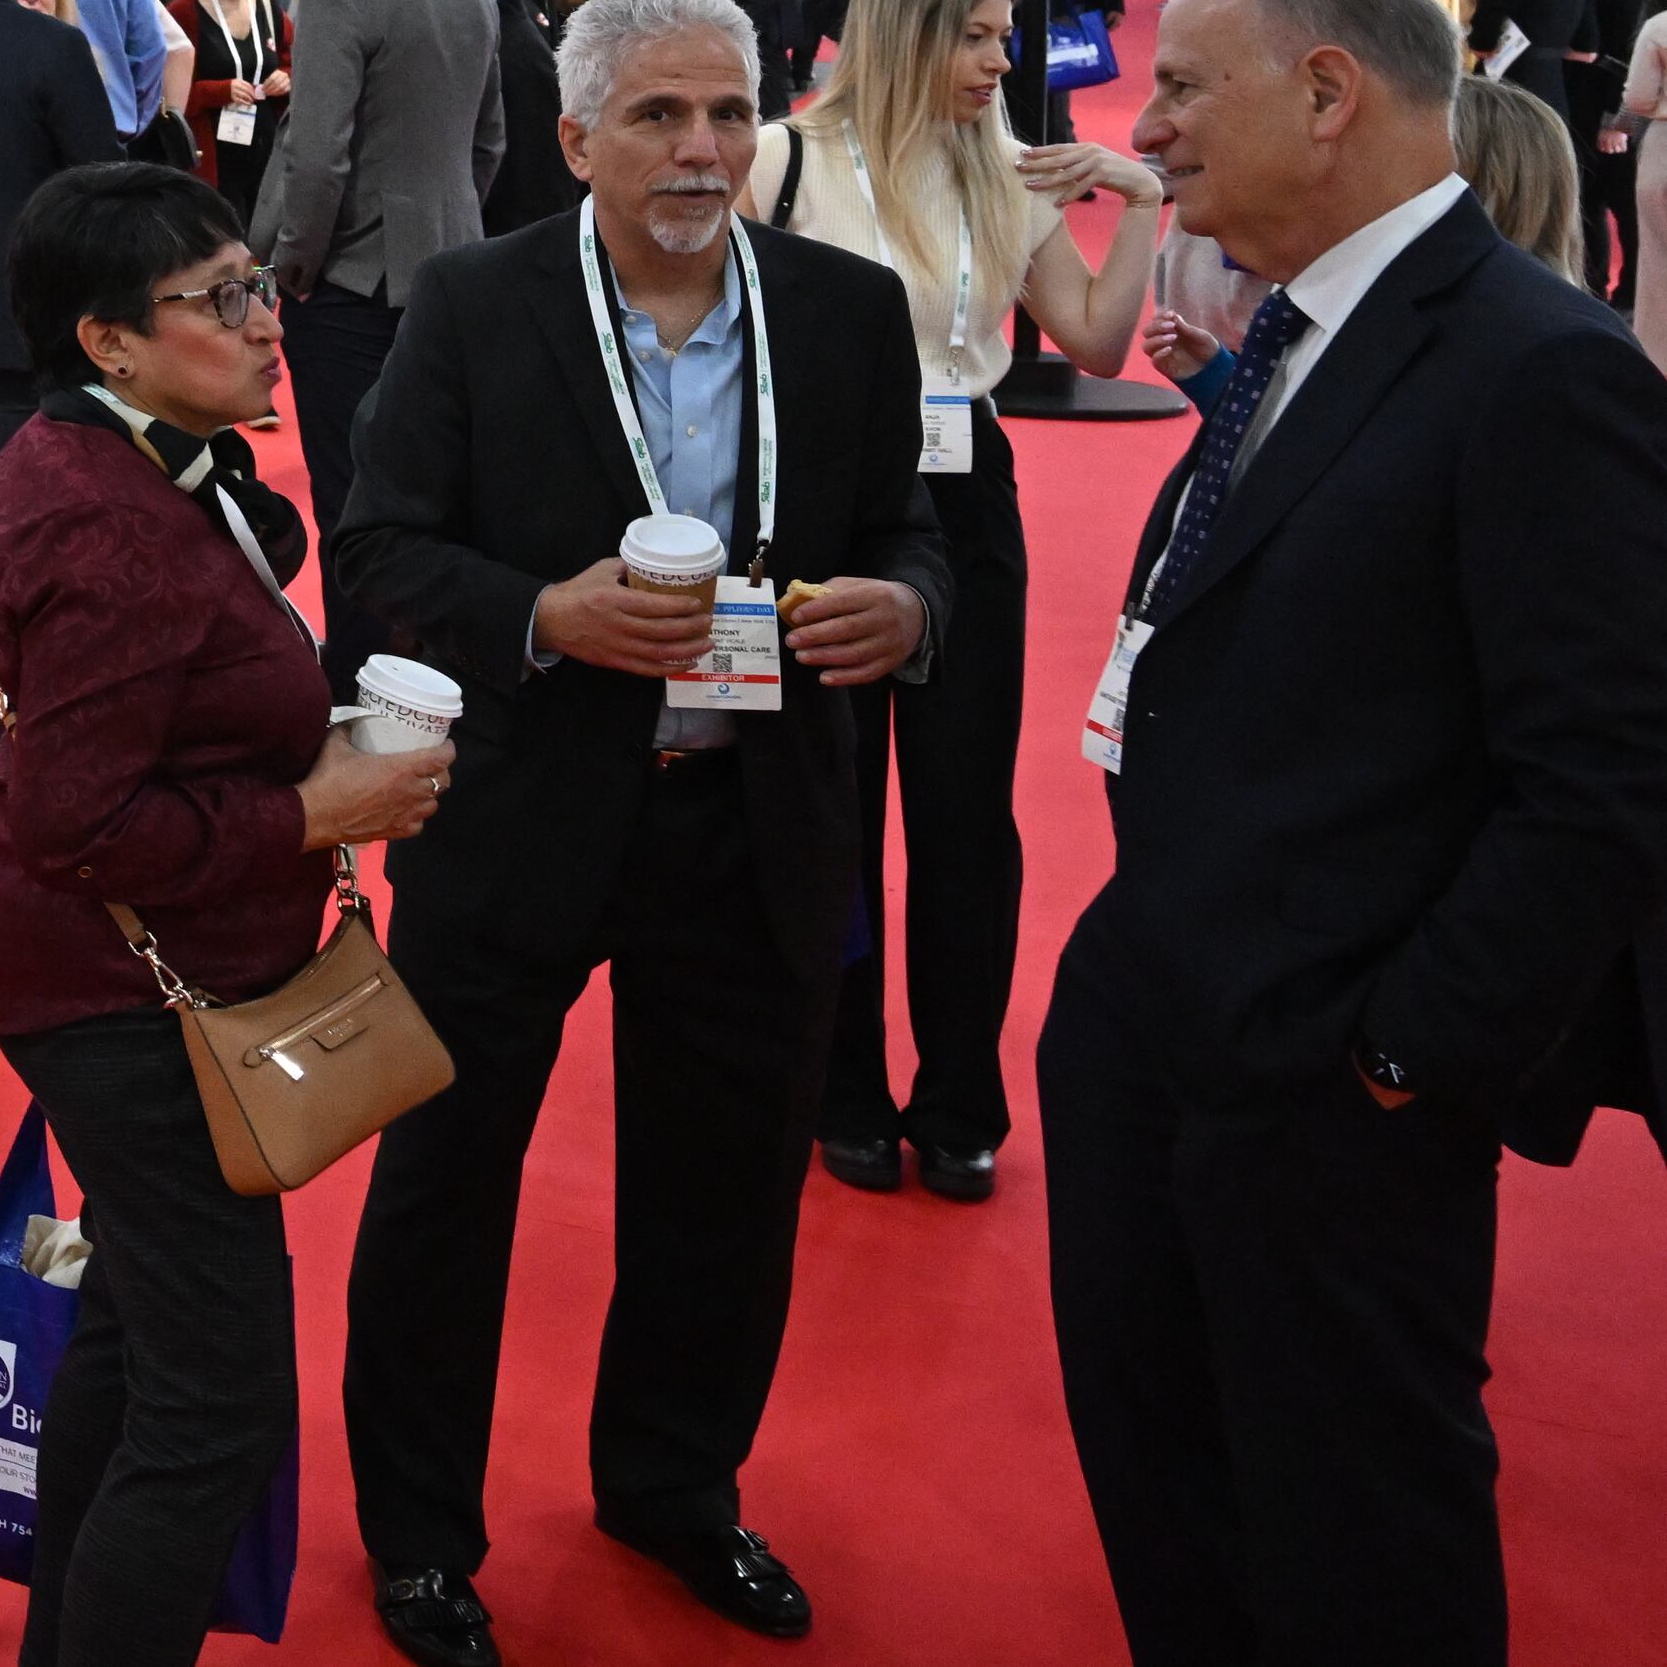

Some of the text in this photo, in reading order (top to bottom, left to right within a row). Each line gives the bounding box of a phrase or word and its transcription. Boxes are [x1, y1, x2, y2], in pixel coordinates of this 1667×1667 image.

[701, 674, 745, 682] EXHIBITOR
[18, 1451, 36, 1465] MEE
[20, 1472, 36, 1484] STO
[10, 1522, 33, 1536] 754
